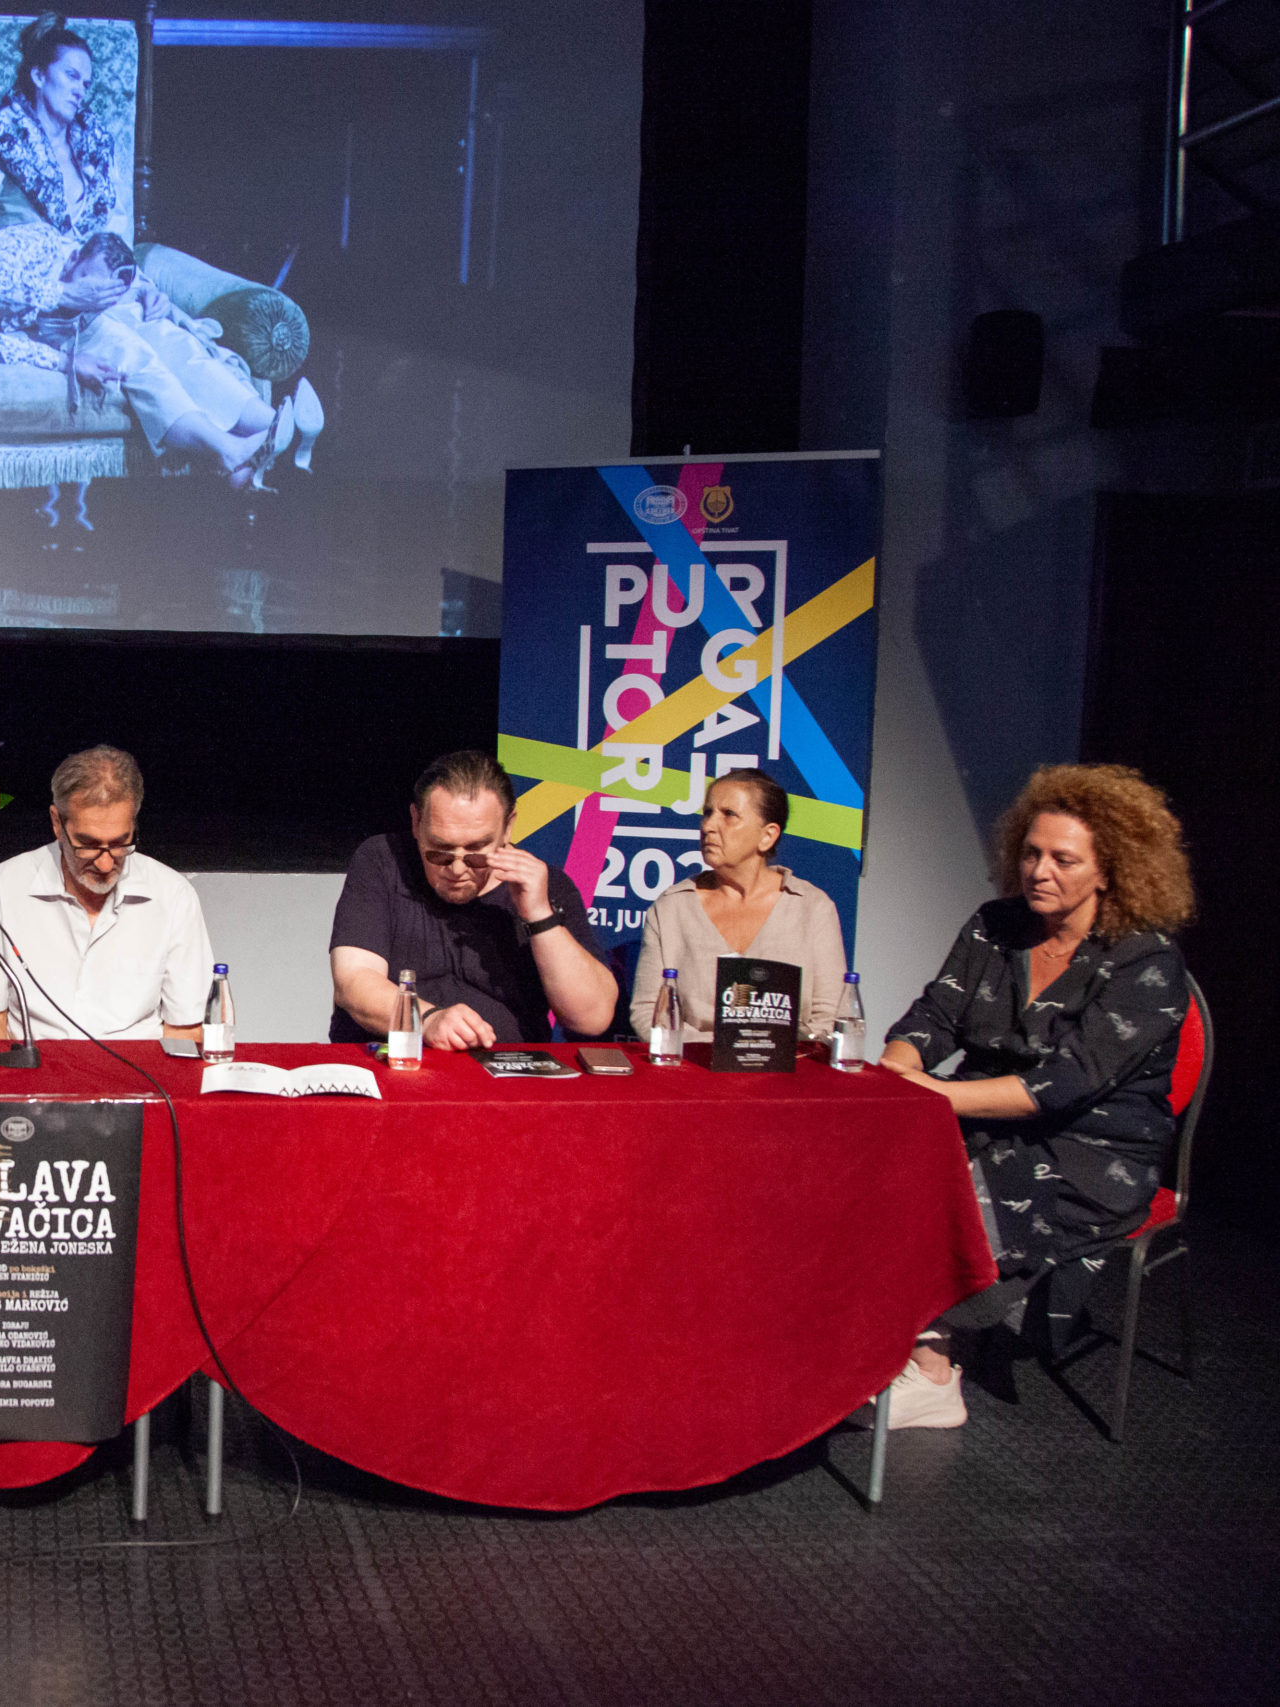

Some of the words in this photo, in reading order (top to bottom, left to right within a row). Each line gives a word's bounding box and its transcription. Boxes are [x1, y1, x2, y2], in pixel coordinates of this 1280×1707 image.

[0, 1238, 47, 1254] EŽENA
[50, 1241, 113, 1255] JONESKA
[5, 1297, 69, 1312] MARKOVIĆ
